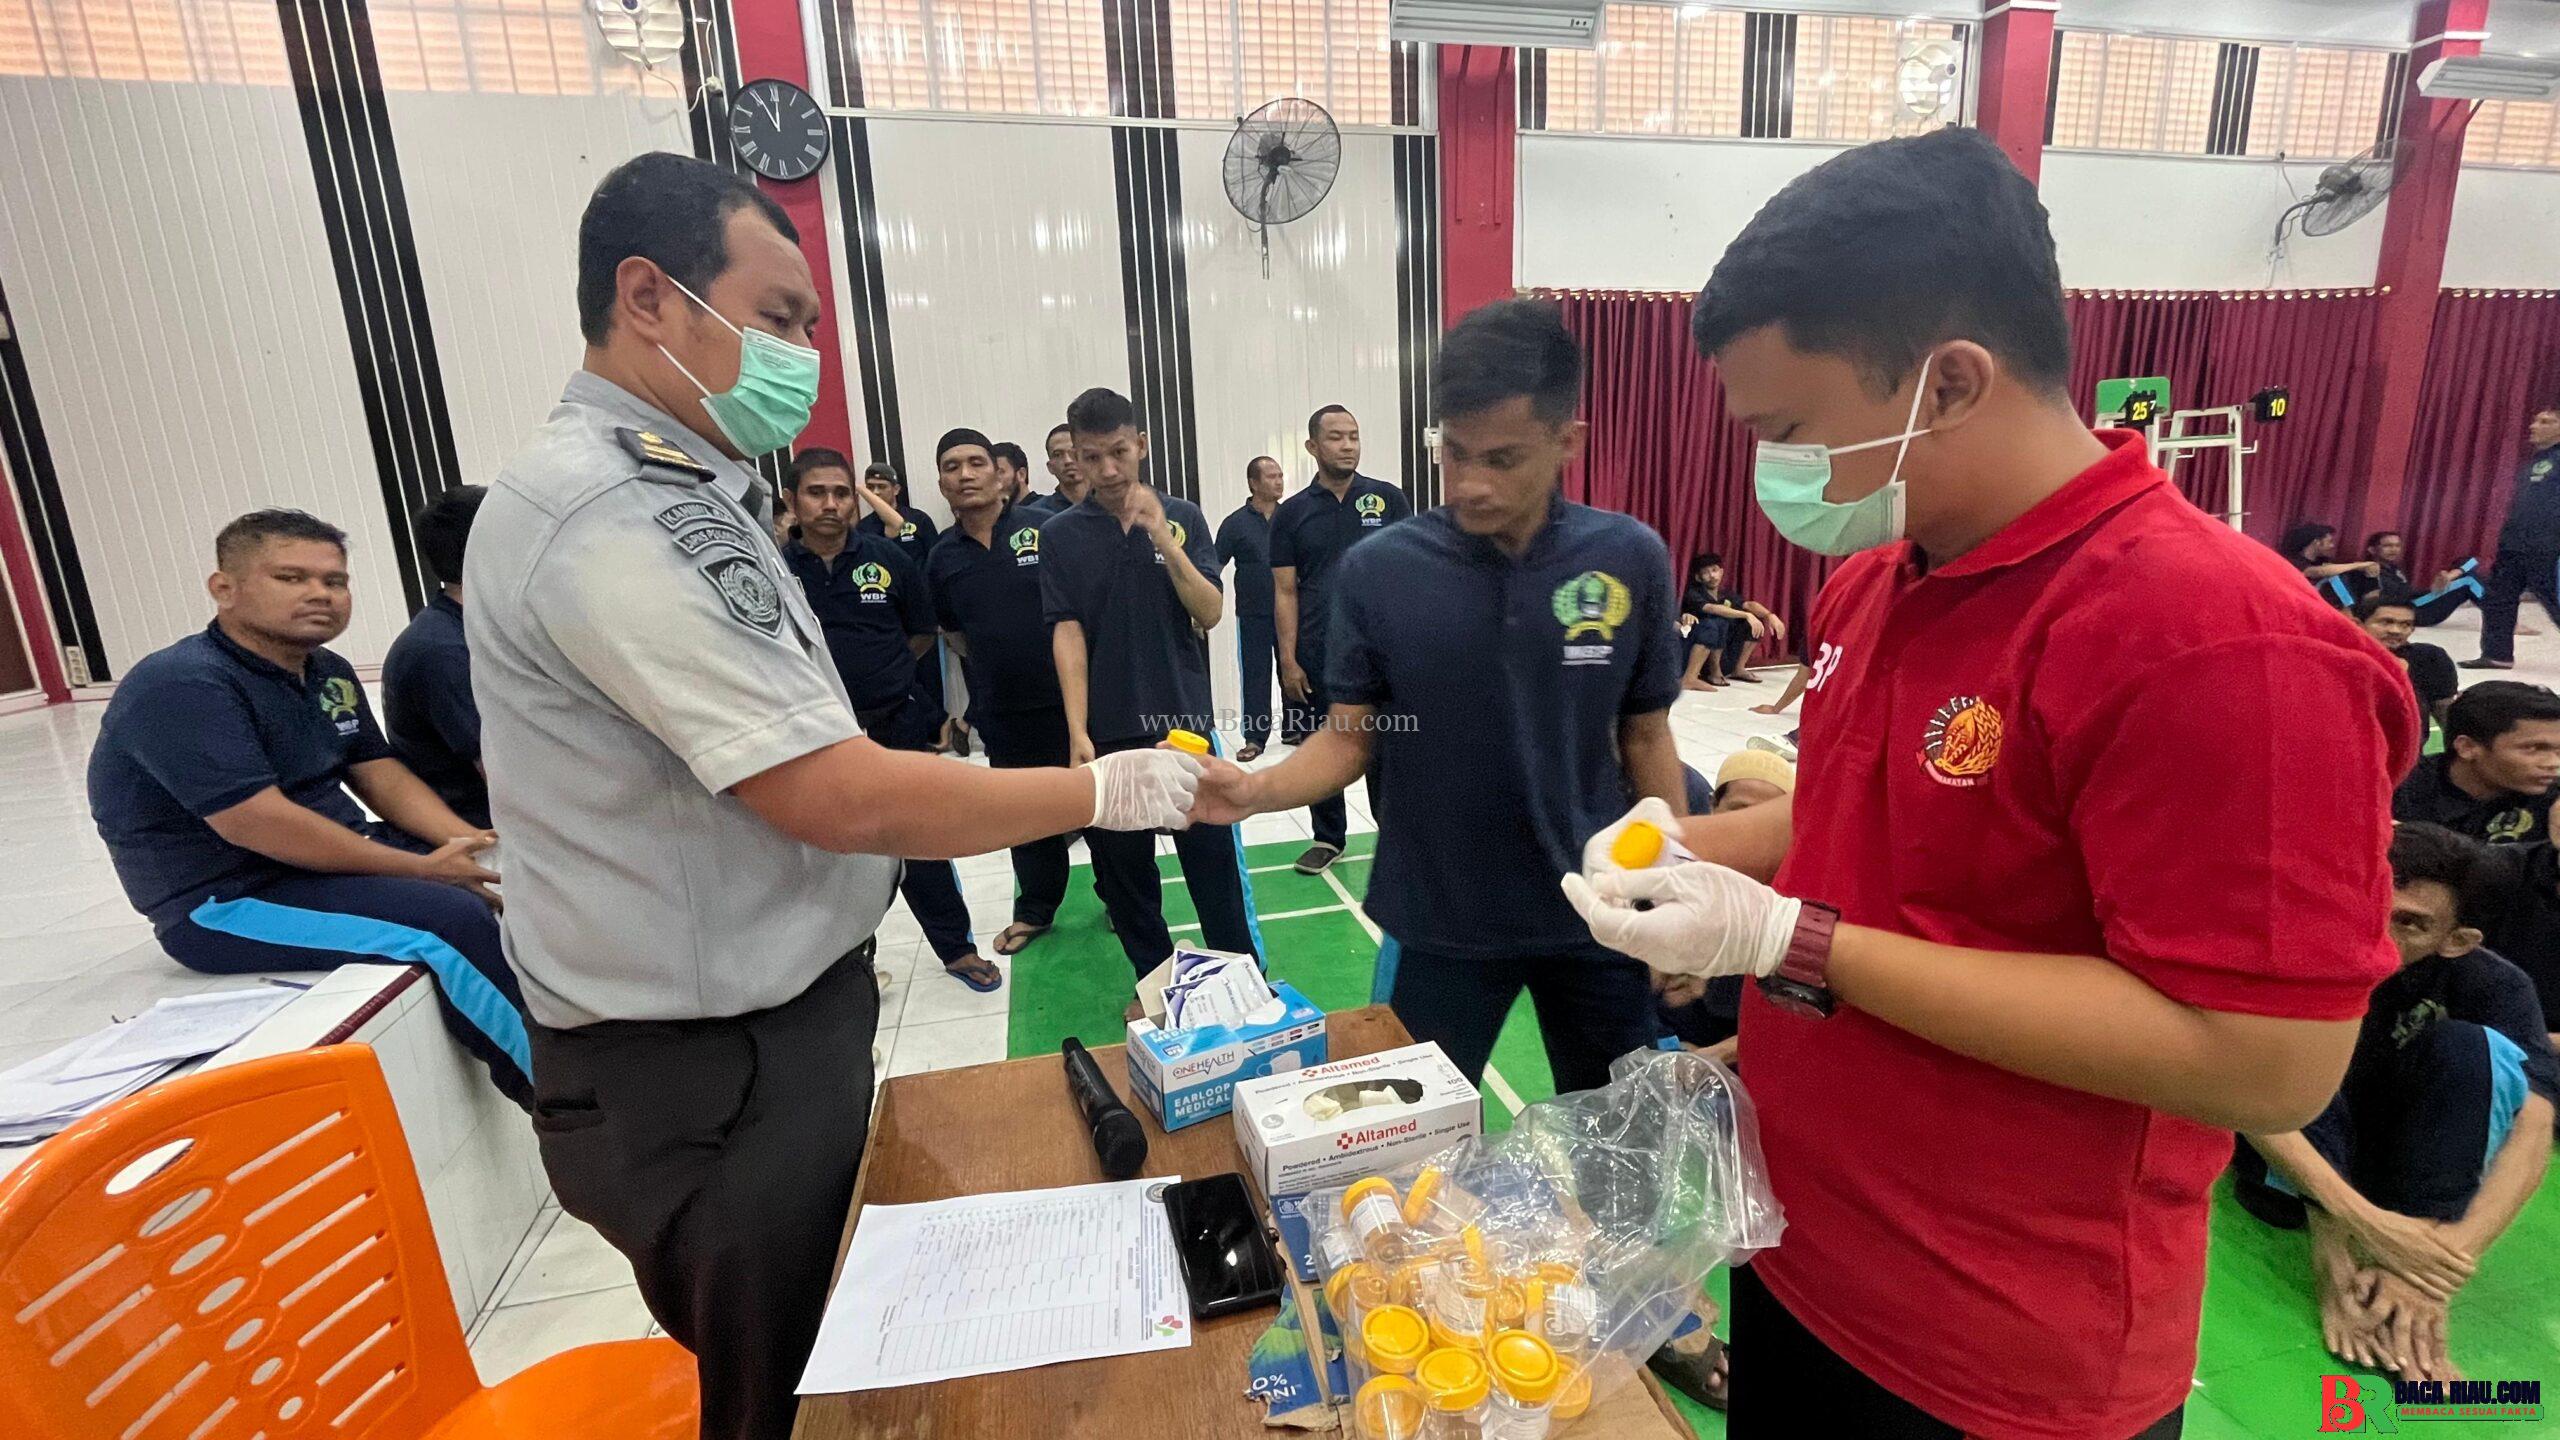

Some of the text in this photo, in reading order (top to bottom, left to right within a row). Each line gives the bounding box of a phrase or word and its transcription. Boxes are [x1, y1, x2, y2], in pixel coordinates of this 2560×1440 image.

[2132, 401, 2148, 420] 25
[2270, 398, 2286, 417] 10
[1319, 1056, 1380, 1075] Altamed
[1174, 1082, 1231, 1108] EARLOOP
[1175, 1093, 1231, 1118] MEDICAL
[1355, 1119, 1417, 1146] Altamed
[1283, 1157, 1321, 1172] Powdered
[1328, 1144, 1379, 1162] Ambidextrous
[1457, 1120, 1471, 1129] Use
